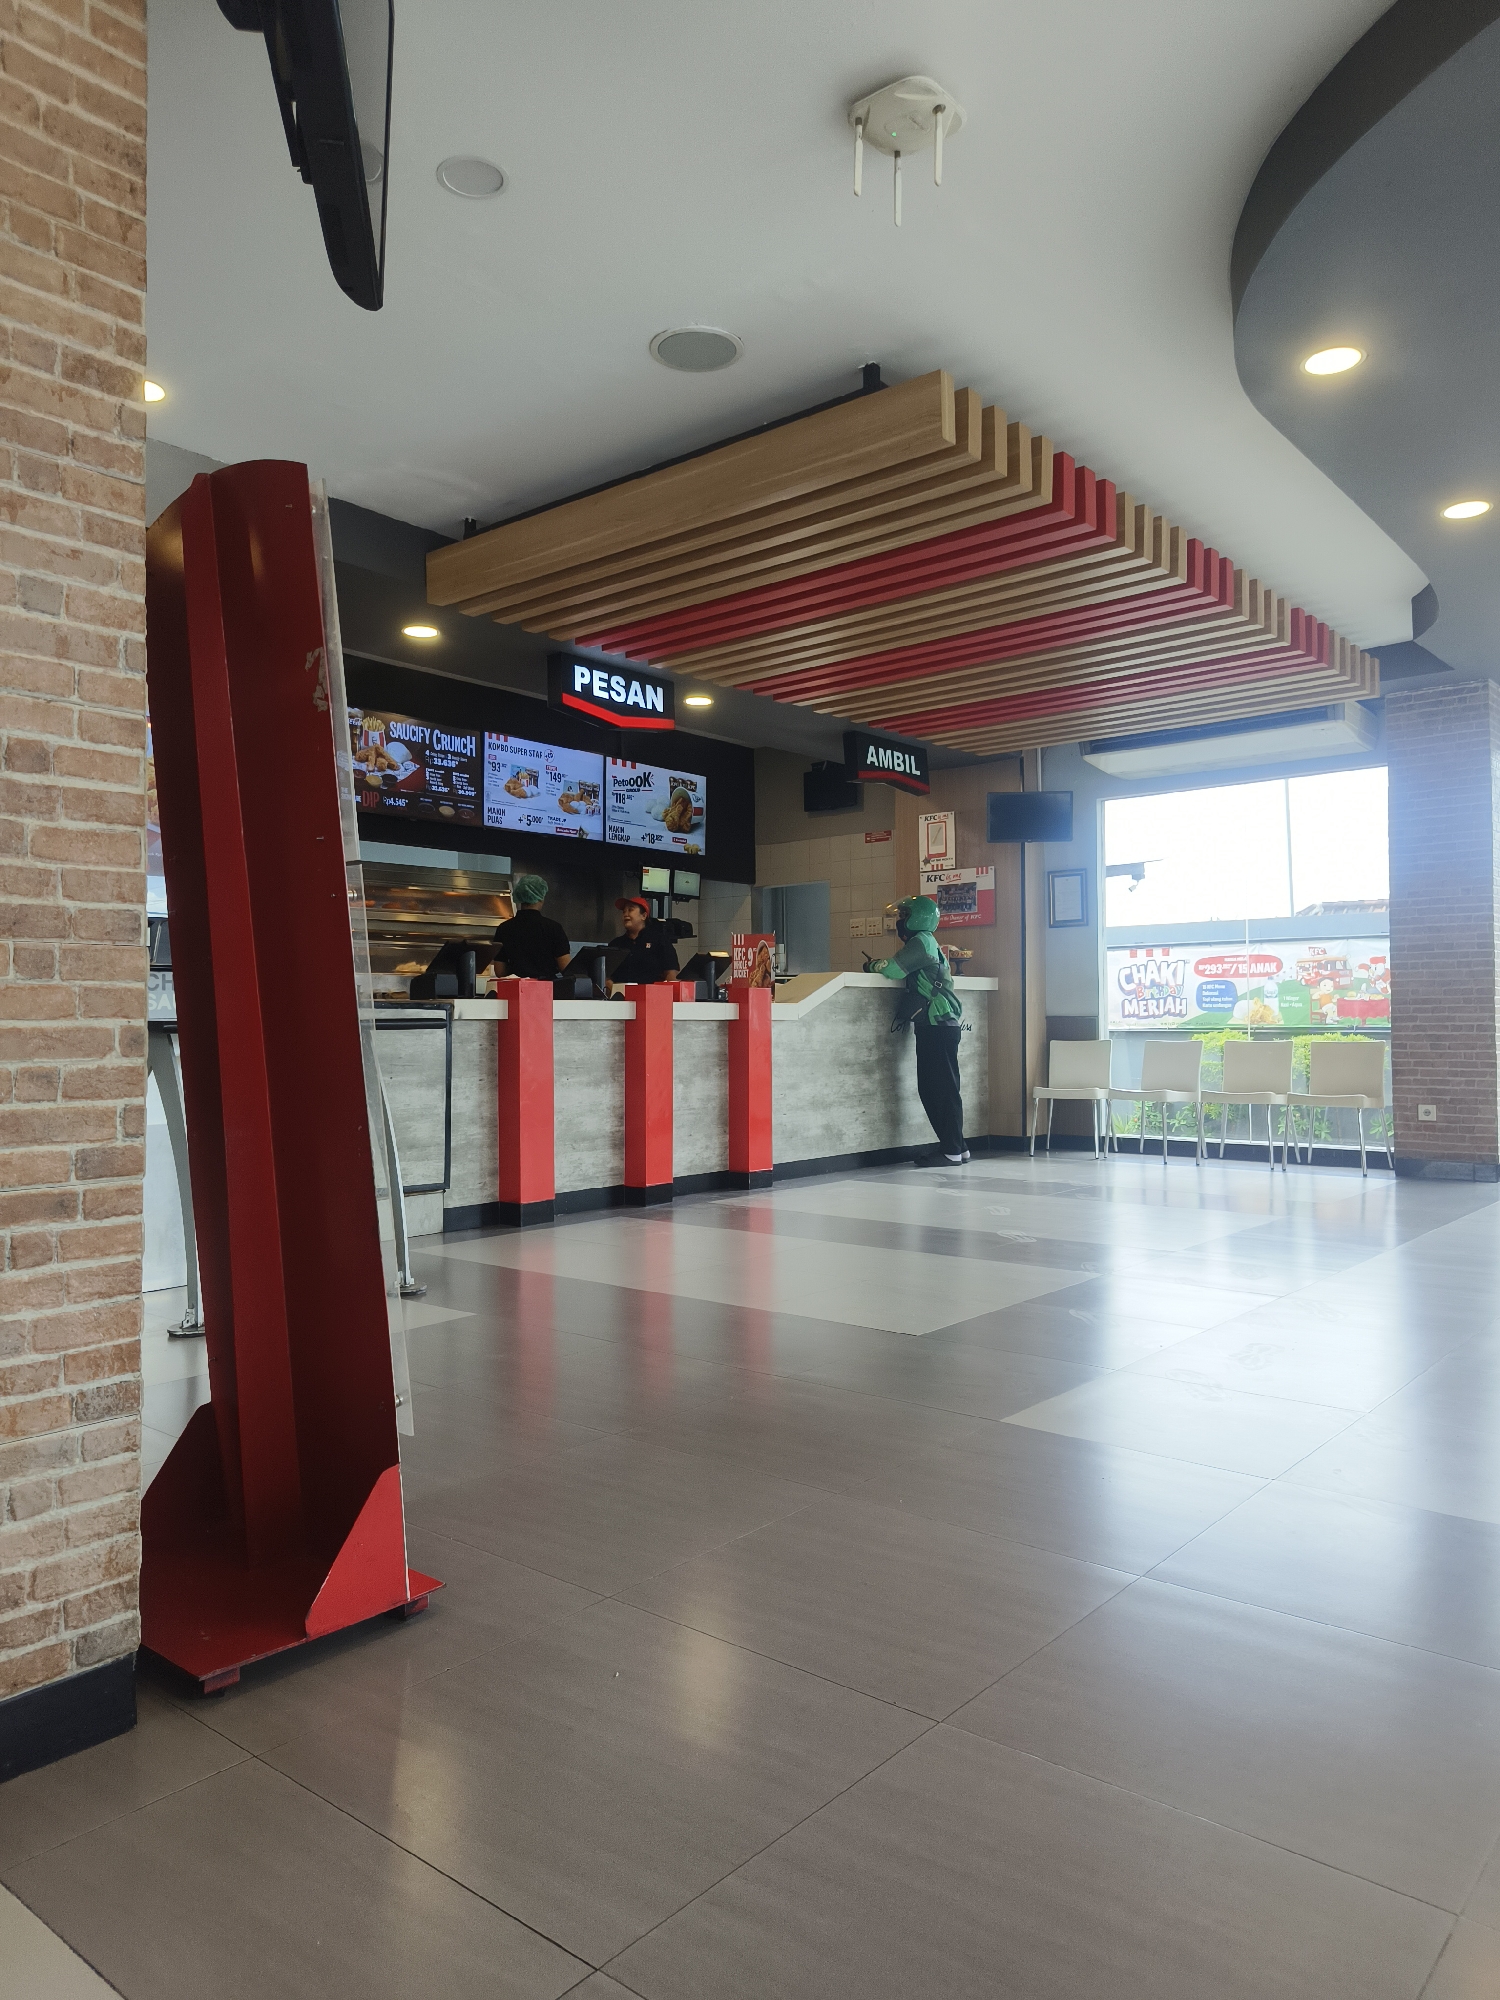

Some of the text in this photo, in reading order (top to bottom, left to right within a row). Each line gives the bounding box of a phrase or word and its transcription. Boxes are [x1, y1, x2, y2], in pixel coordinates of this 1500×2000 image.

[573, 664, 664, 713] PESAN
[389, 721, 476, 758] SAUCIFY CRUNCH
[488, 742, 508, 752] KOMBO
[509, 746, 528, 757] SUPER
[866, 745, 921, 776] AMBIL
[362, 790, 380, 808] DIP
[487, 814, 503, 825] PUAS
[924, 814, 938, 822] KFC
[608, 832, 631, 843] LENGKAP
[926, 873, 946, 883] KFC
[734, 948, 745, 960] KFC
[1309, 947, 1326, 956] KFC
[734, 970, 748, 978] BUCKET
[1249, 962, 1278, 974] ANAK
[1118, 959, 1186, 996] CHAKI
[1121, 996, 1188, 1019] MERIAH
